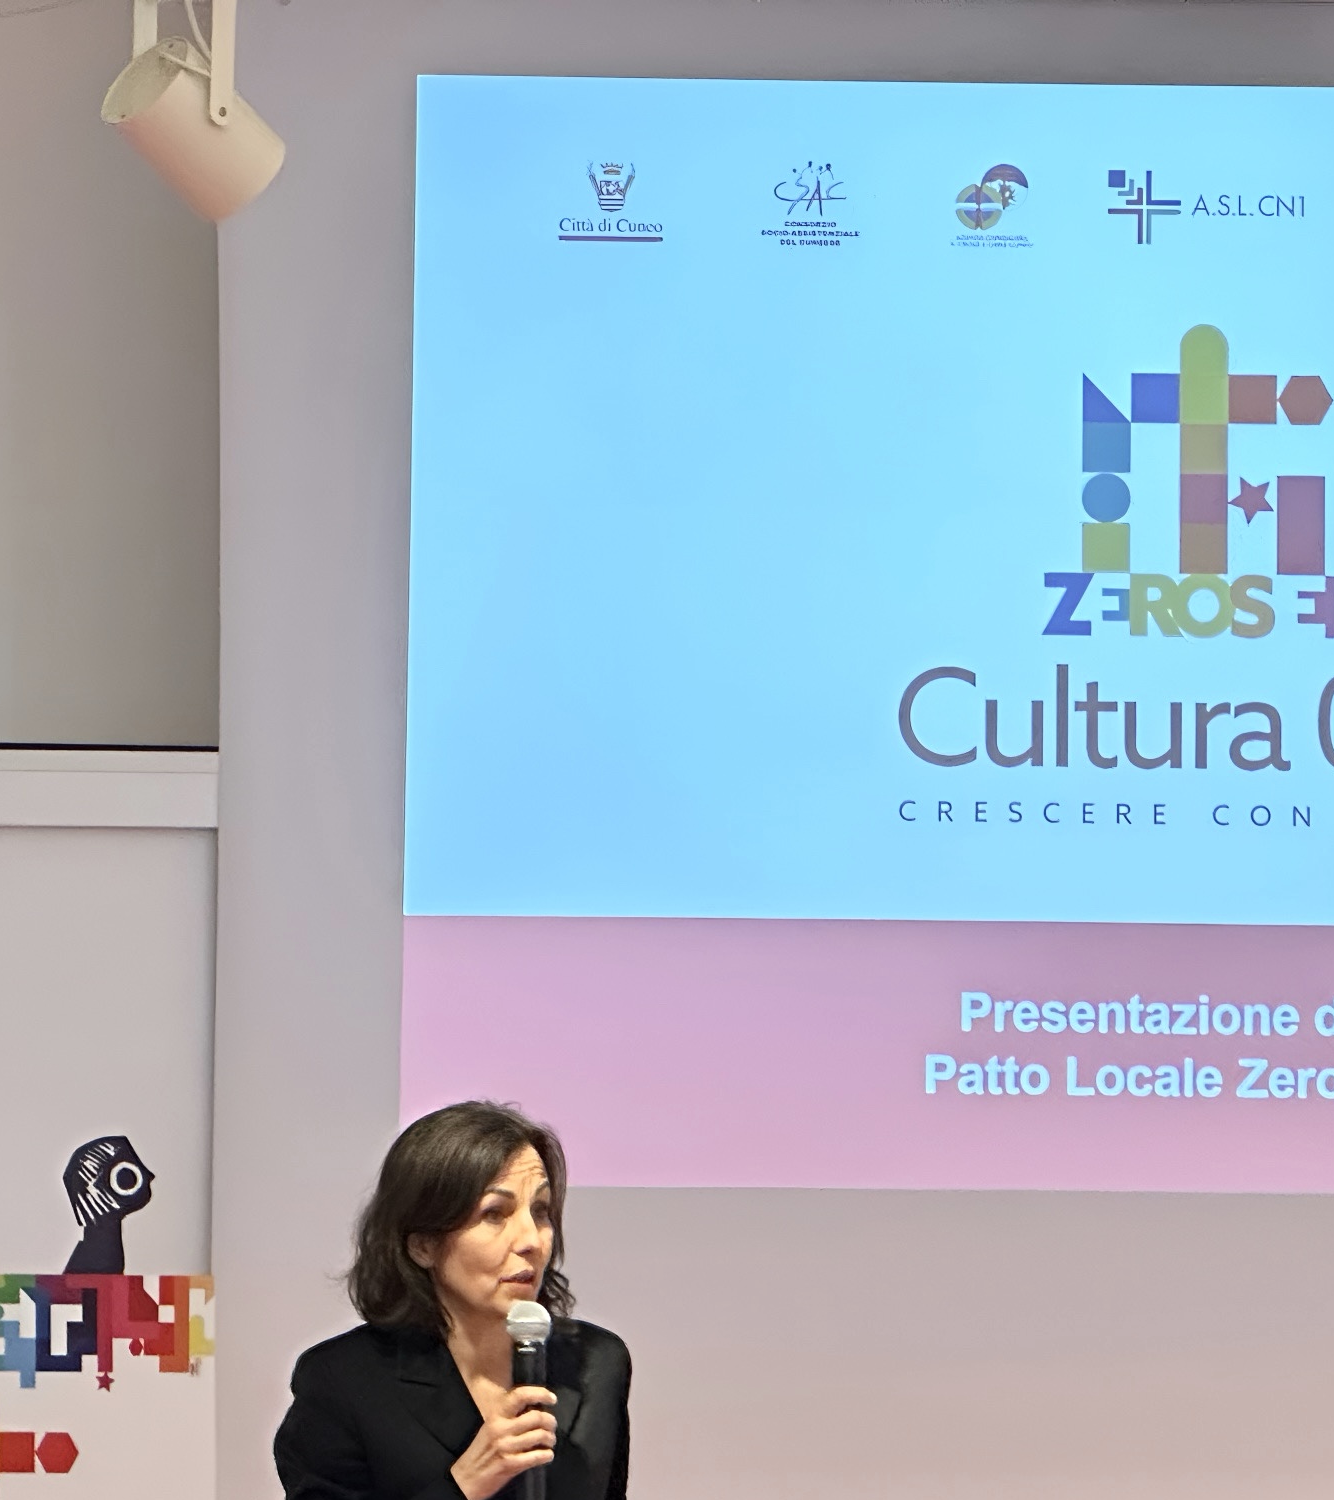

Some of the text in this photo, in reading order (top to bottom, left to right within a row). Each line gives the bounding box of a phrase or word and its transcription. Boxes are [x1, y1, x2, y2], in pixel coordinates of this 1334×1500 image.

[1190, 194, 1306, 218] A.S.L. CN1
[558, 216, 664, 234] Città di Cuneo
[897, 662, 1291, 772] Cultura
[898, 799, 1168, 826] CRESCERE
[1211, 803, 1313, 828] CON
[960, 991, 1300, 1037] Presentazione
[924, 1053, 1051, 1096] Patto
[1065, 1055, 1223, 1099] Locale
